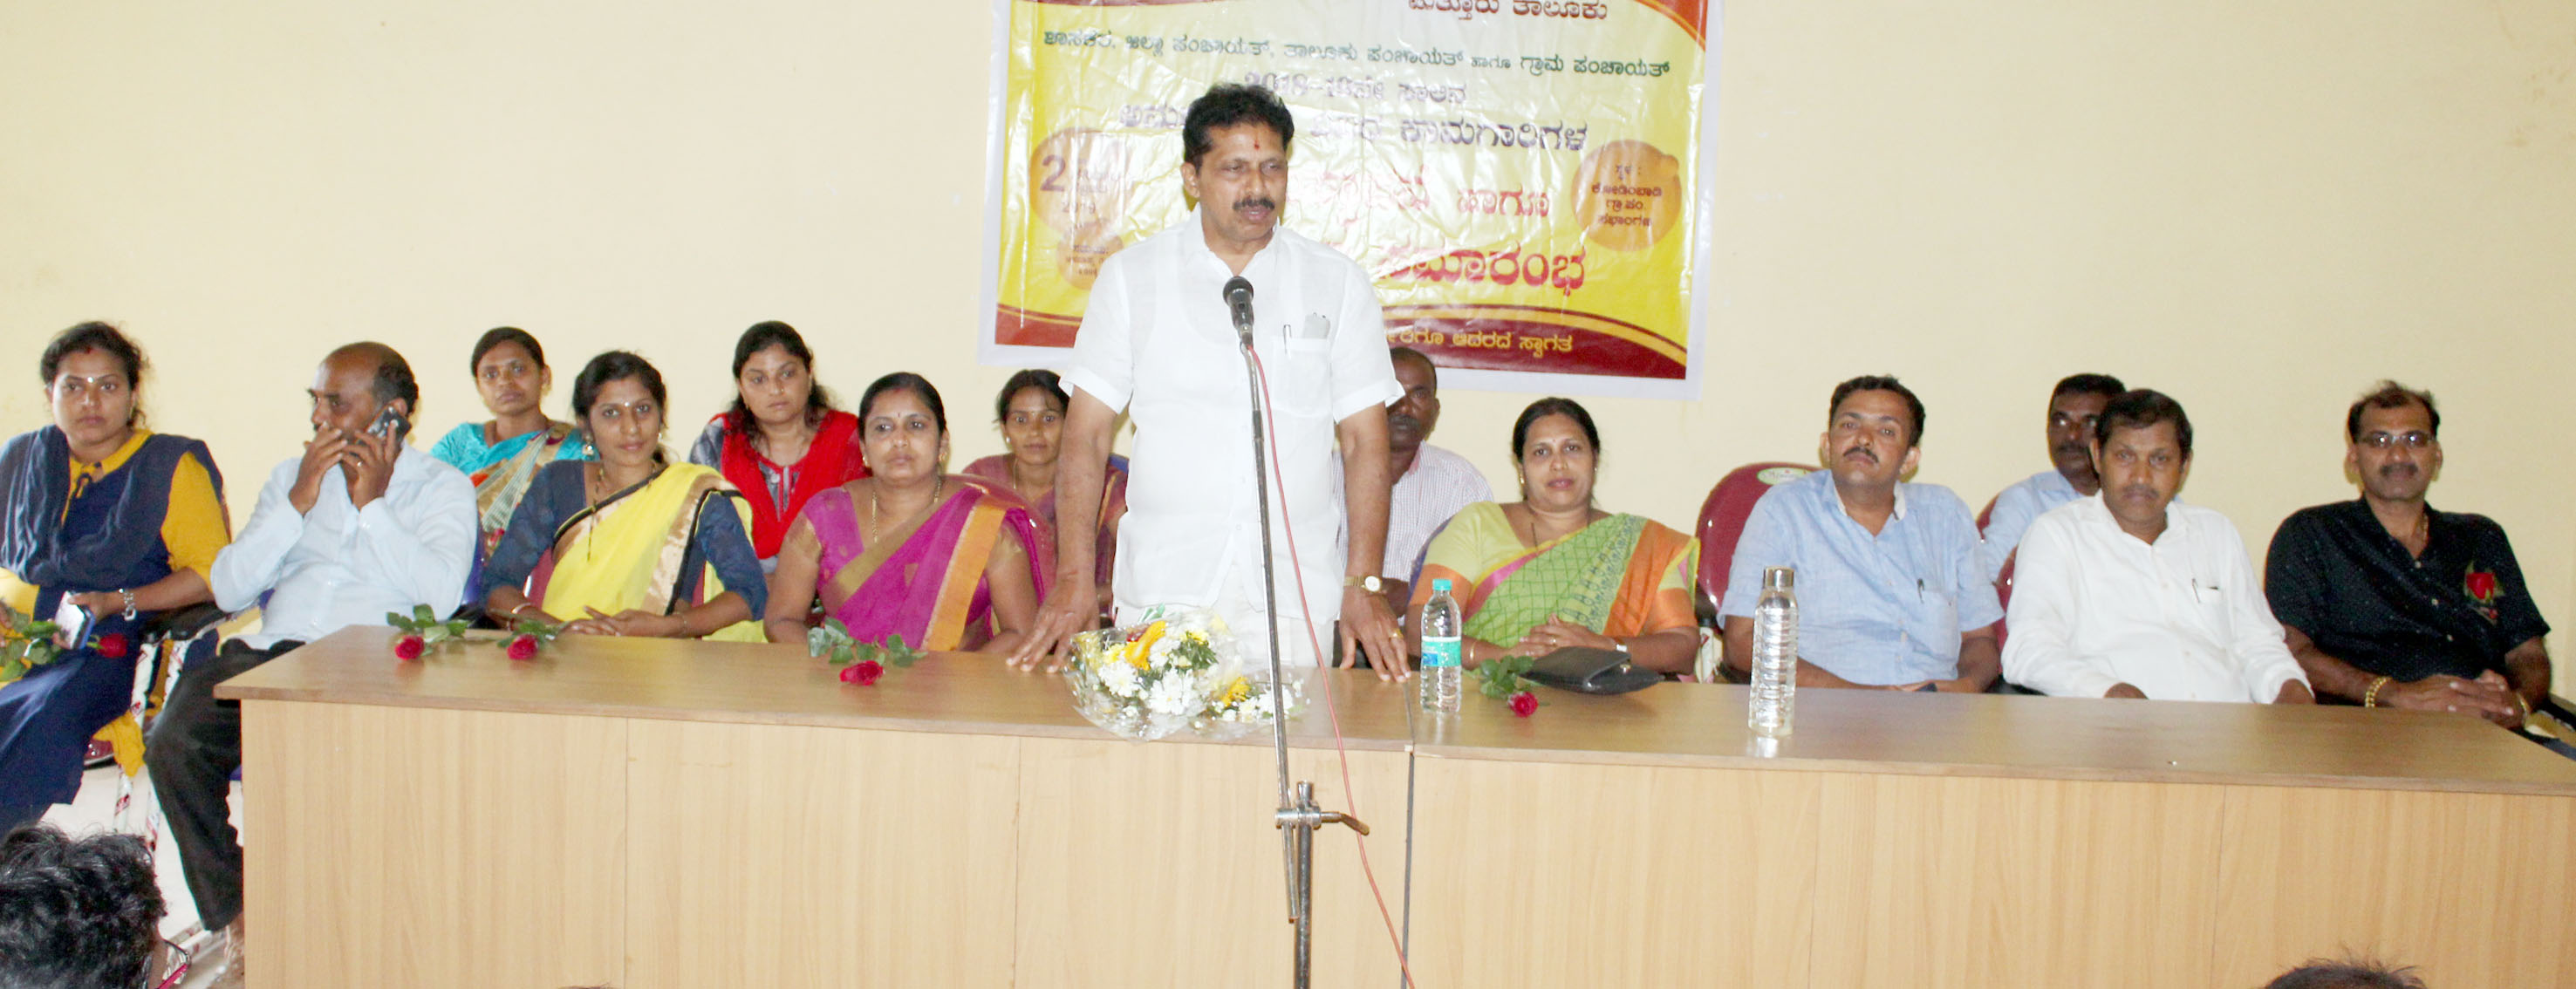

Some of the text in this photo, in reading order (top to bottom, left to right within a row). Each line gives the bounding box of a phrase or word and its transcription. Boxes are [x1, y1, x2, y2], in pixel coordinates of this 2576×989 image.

[1520, 52, 1564, 77] ಗ್ರಾಮ
[1573, 55, 1671, 78] ಪಂಚಾಯತ್
[1400, 116, 1589, 151] ಕಾಮಗಾರಿಗಳ
[1456, 181, 1551, 218] ಹಾಗೂ
[1452, 330, 1512, 349] ಆದರದ
[1519, 333, 1574, 358] ಸ್ವಾಗತ
